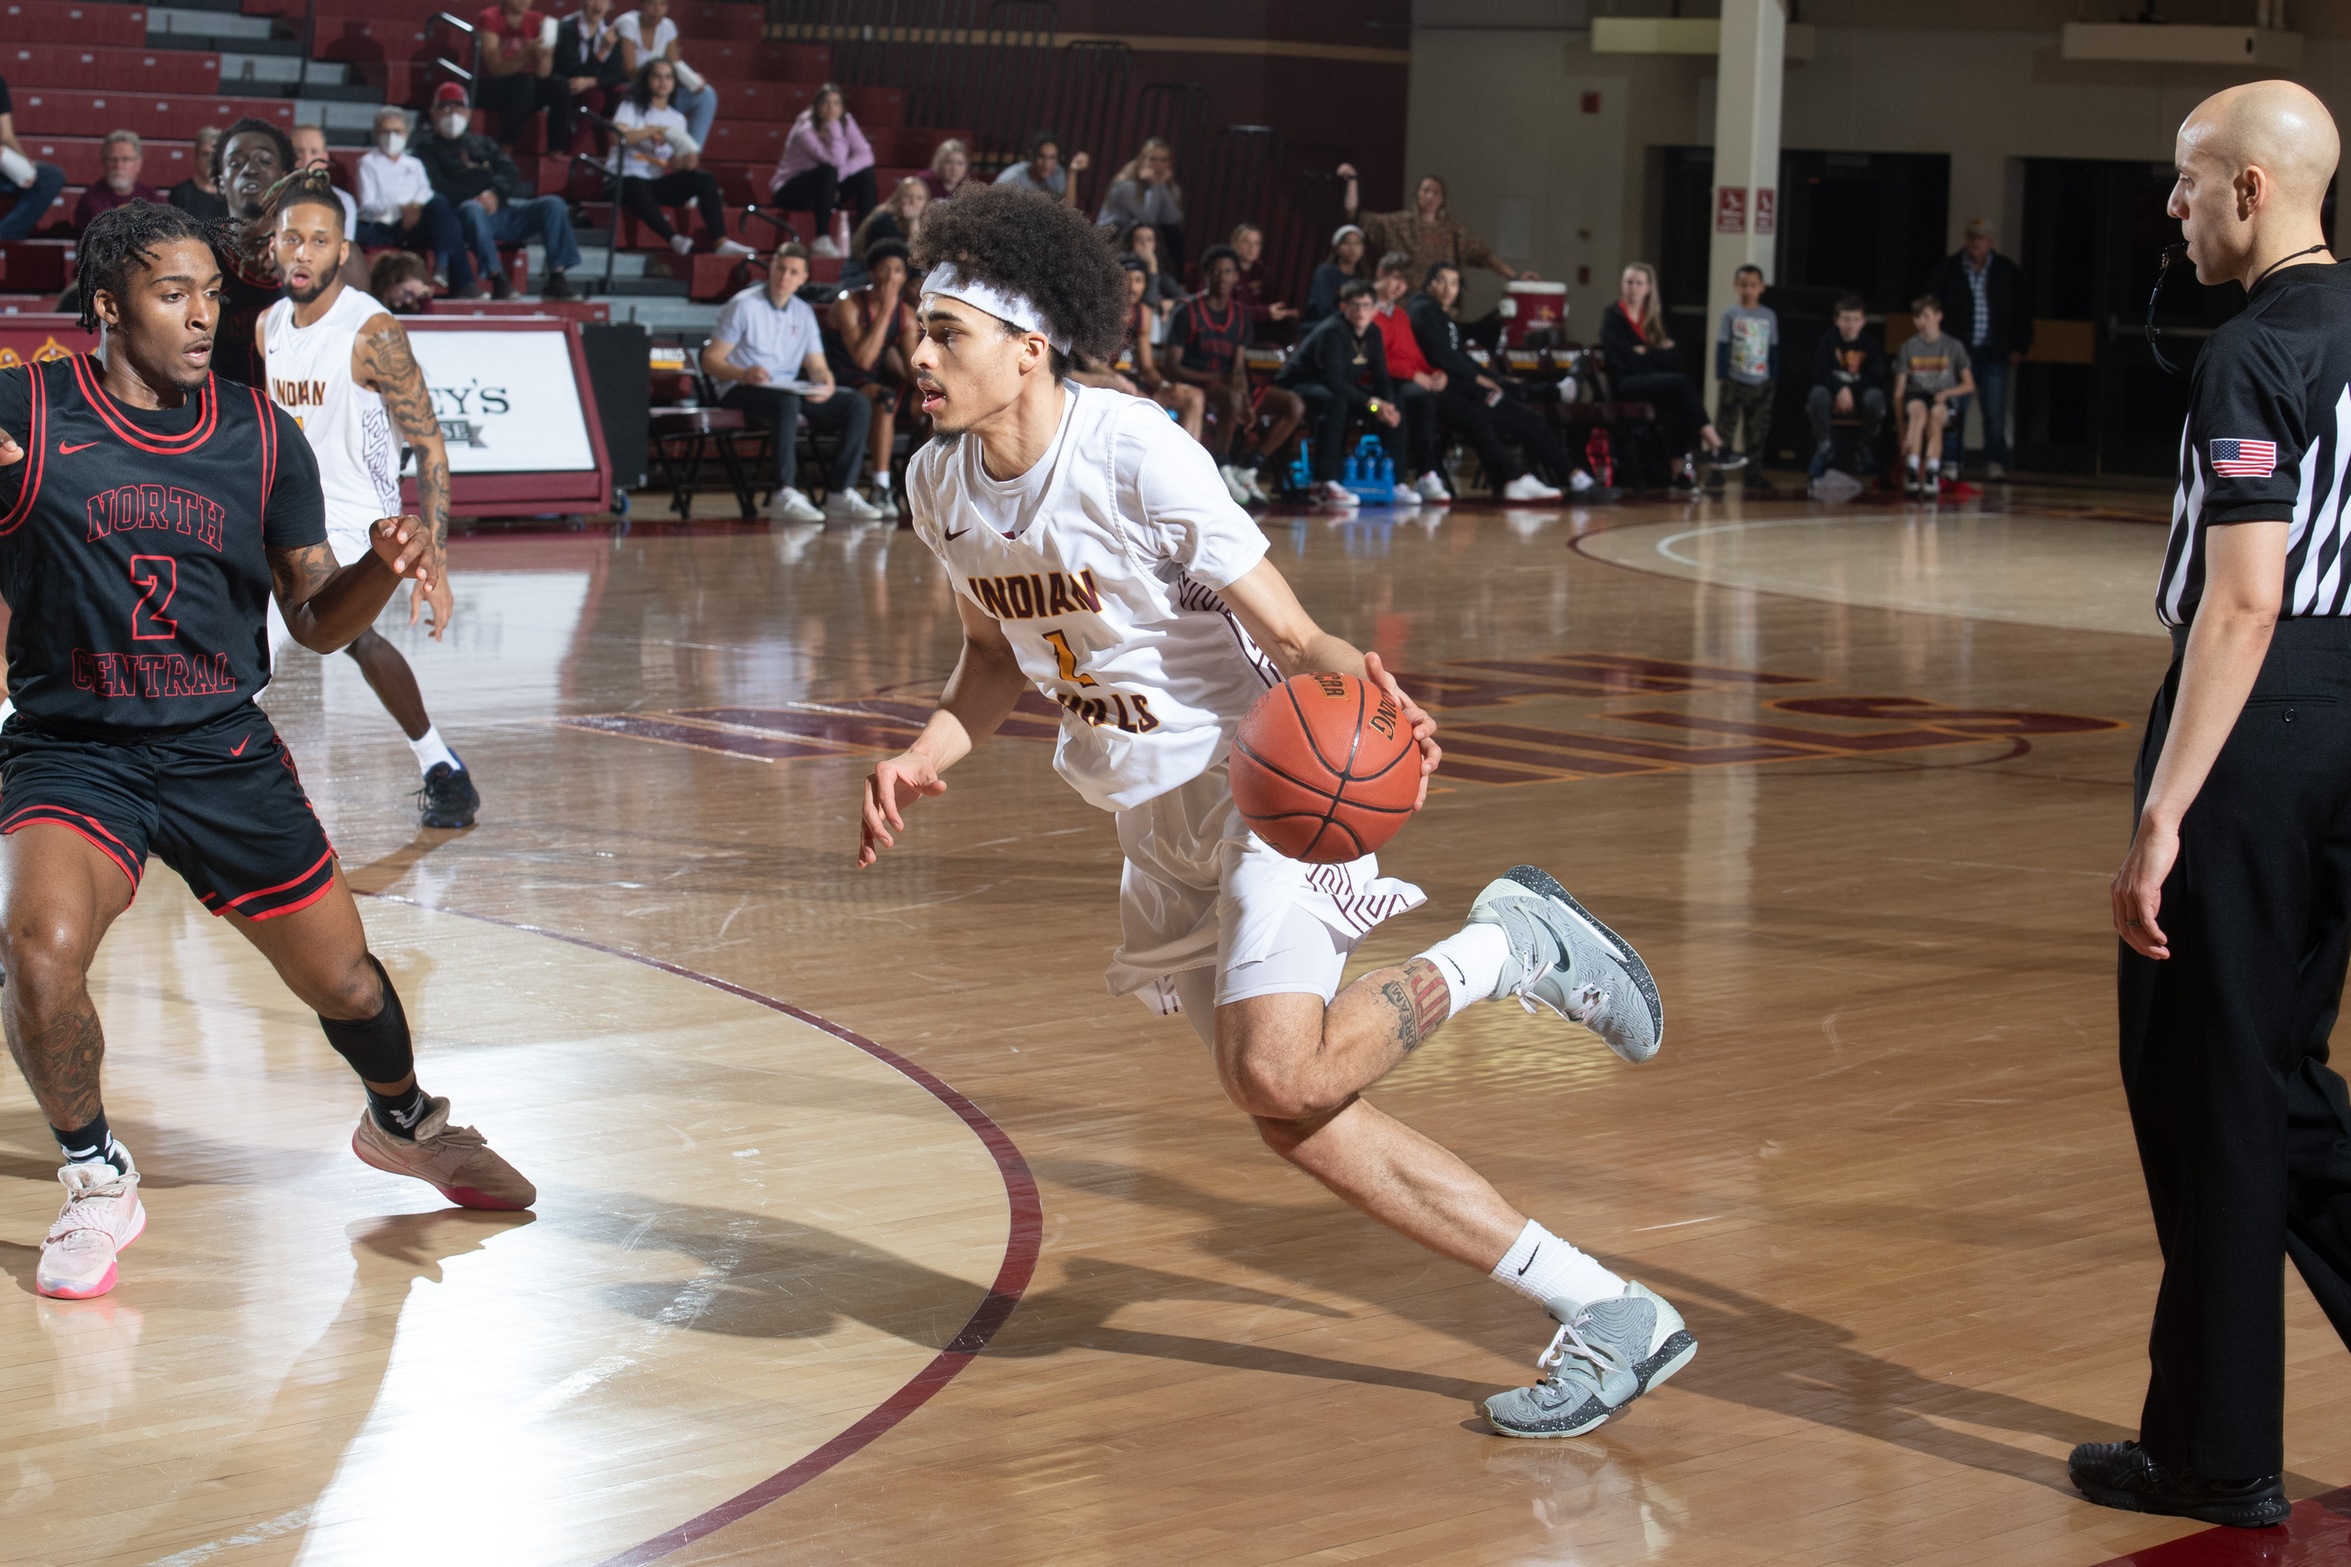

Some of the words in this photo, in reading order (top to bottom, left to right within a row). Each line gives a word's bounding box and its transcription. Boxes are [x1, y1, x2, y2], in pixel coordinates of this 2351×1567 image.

[87, 483, 225, 552] NORTH
[130, 554, 178, 640] 2
[967, 569, 1102, 619] INDIAN
[72, 648, 236, 698] CENTRAL
[1313, 672, 1345, 697] CAA
